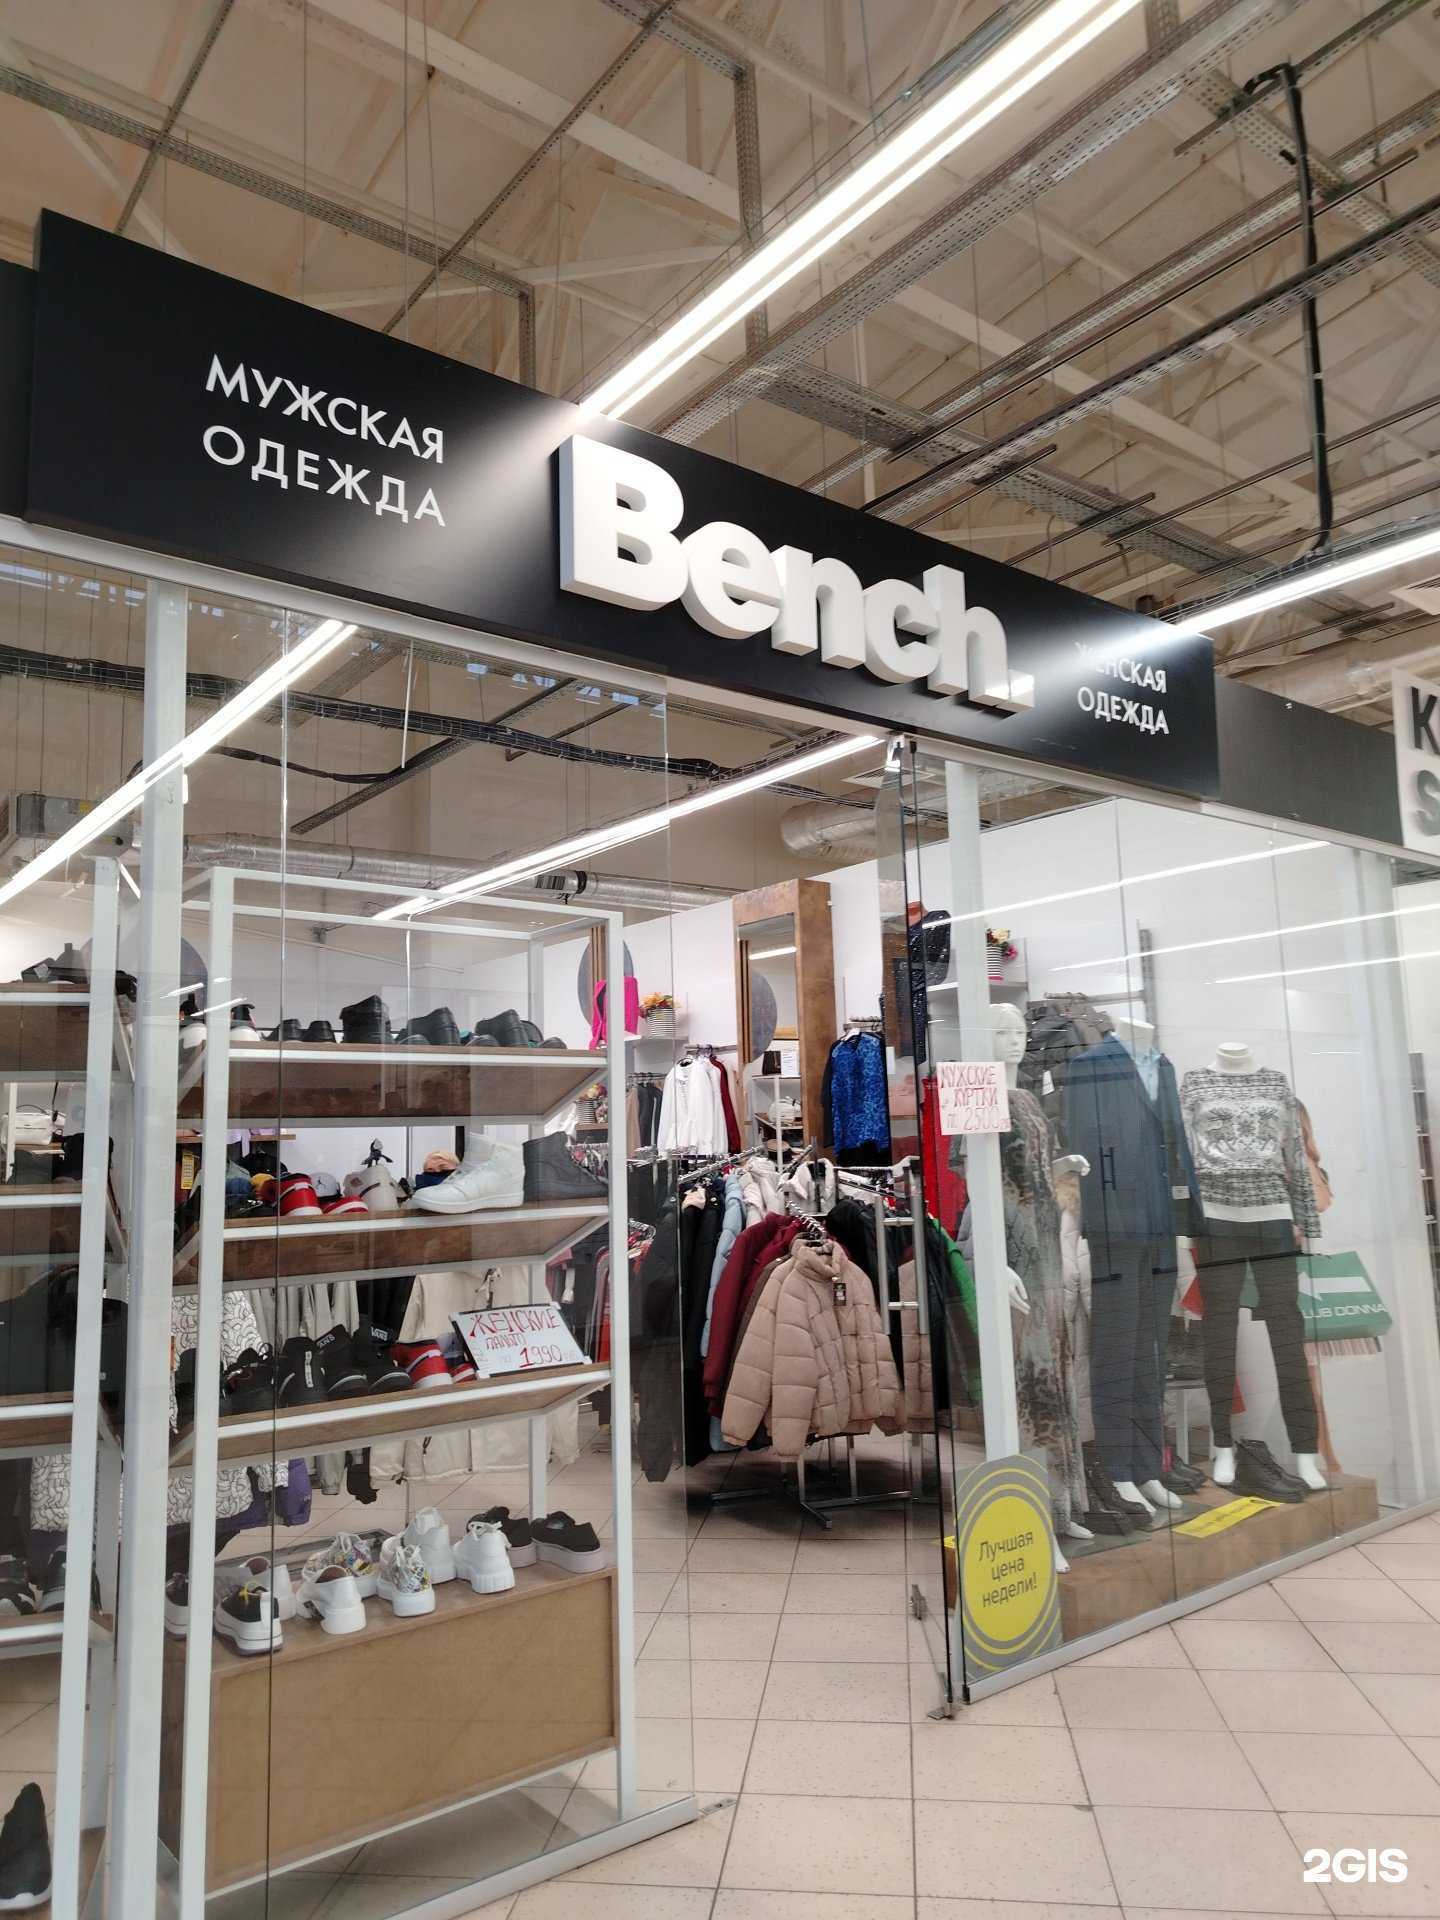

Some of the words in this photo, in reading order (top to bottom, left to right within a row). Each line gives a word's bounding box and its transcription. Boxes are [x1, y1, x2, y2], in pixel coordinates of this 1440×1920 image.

[205, 353, 444, 464] МУЖСКАЯ
[202, 424, 447, 528] ОДЕЖДА
[1074, 640, 1168, 694] НСКАЯ
[1077, 685, 1170, 736] ОДЕЖДА
[469, 1308, 561, 1338] ЖЕНСКИЕ
[1301, 1307, 1333, 1319] LUB
[518, 1343, 563, 1368] 1990
[978, 1531, 1035, 1562] Лучшая
[990, 1557, 1025, 1582] цена
[982, 1571, 1038, 1608] недели!
